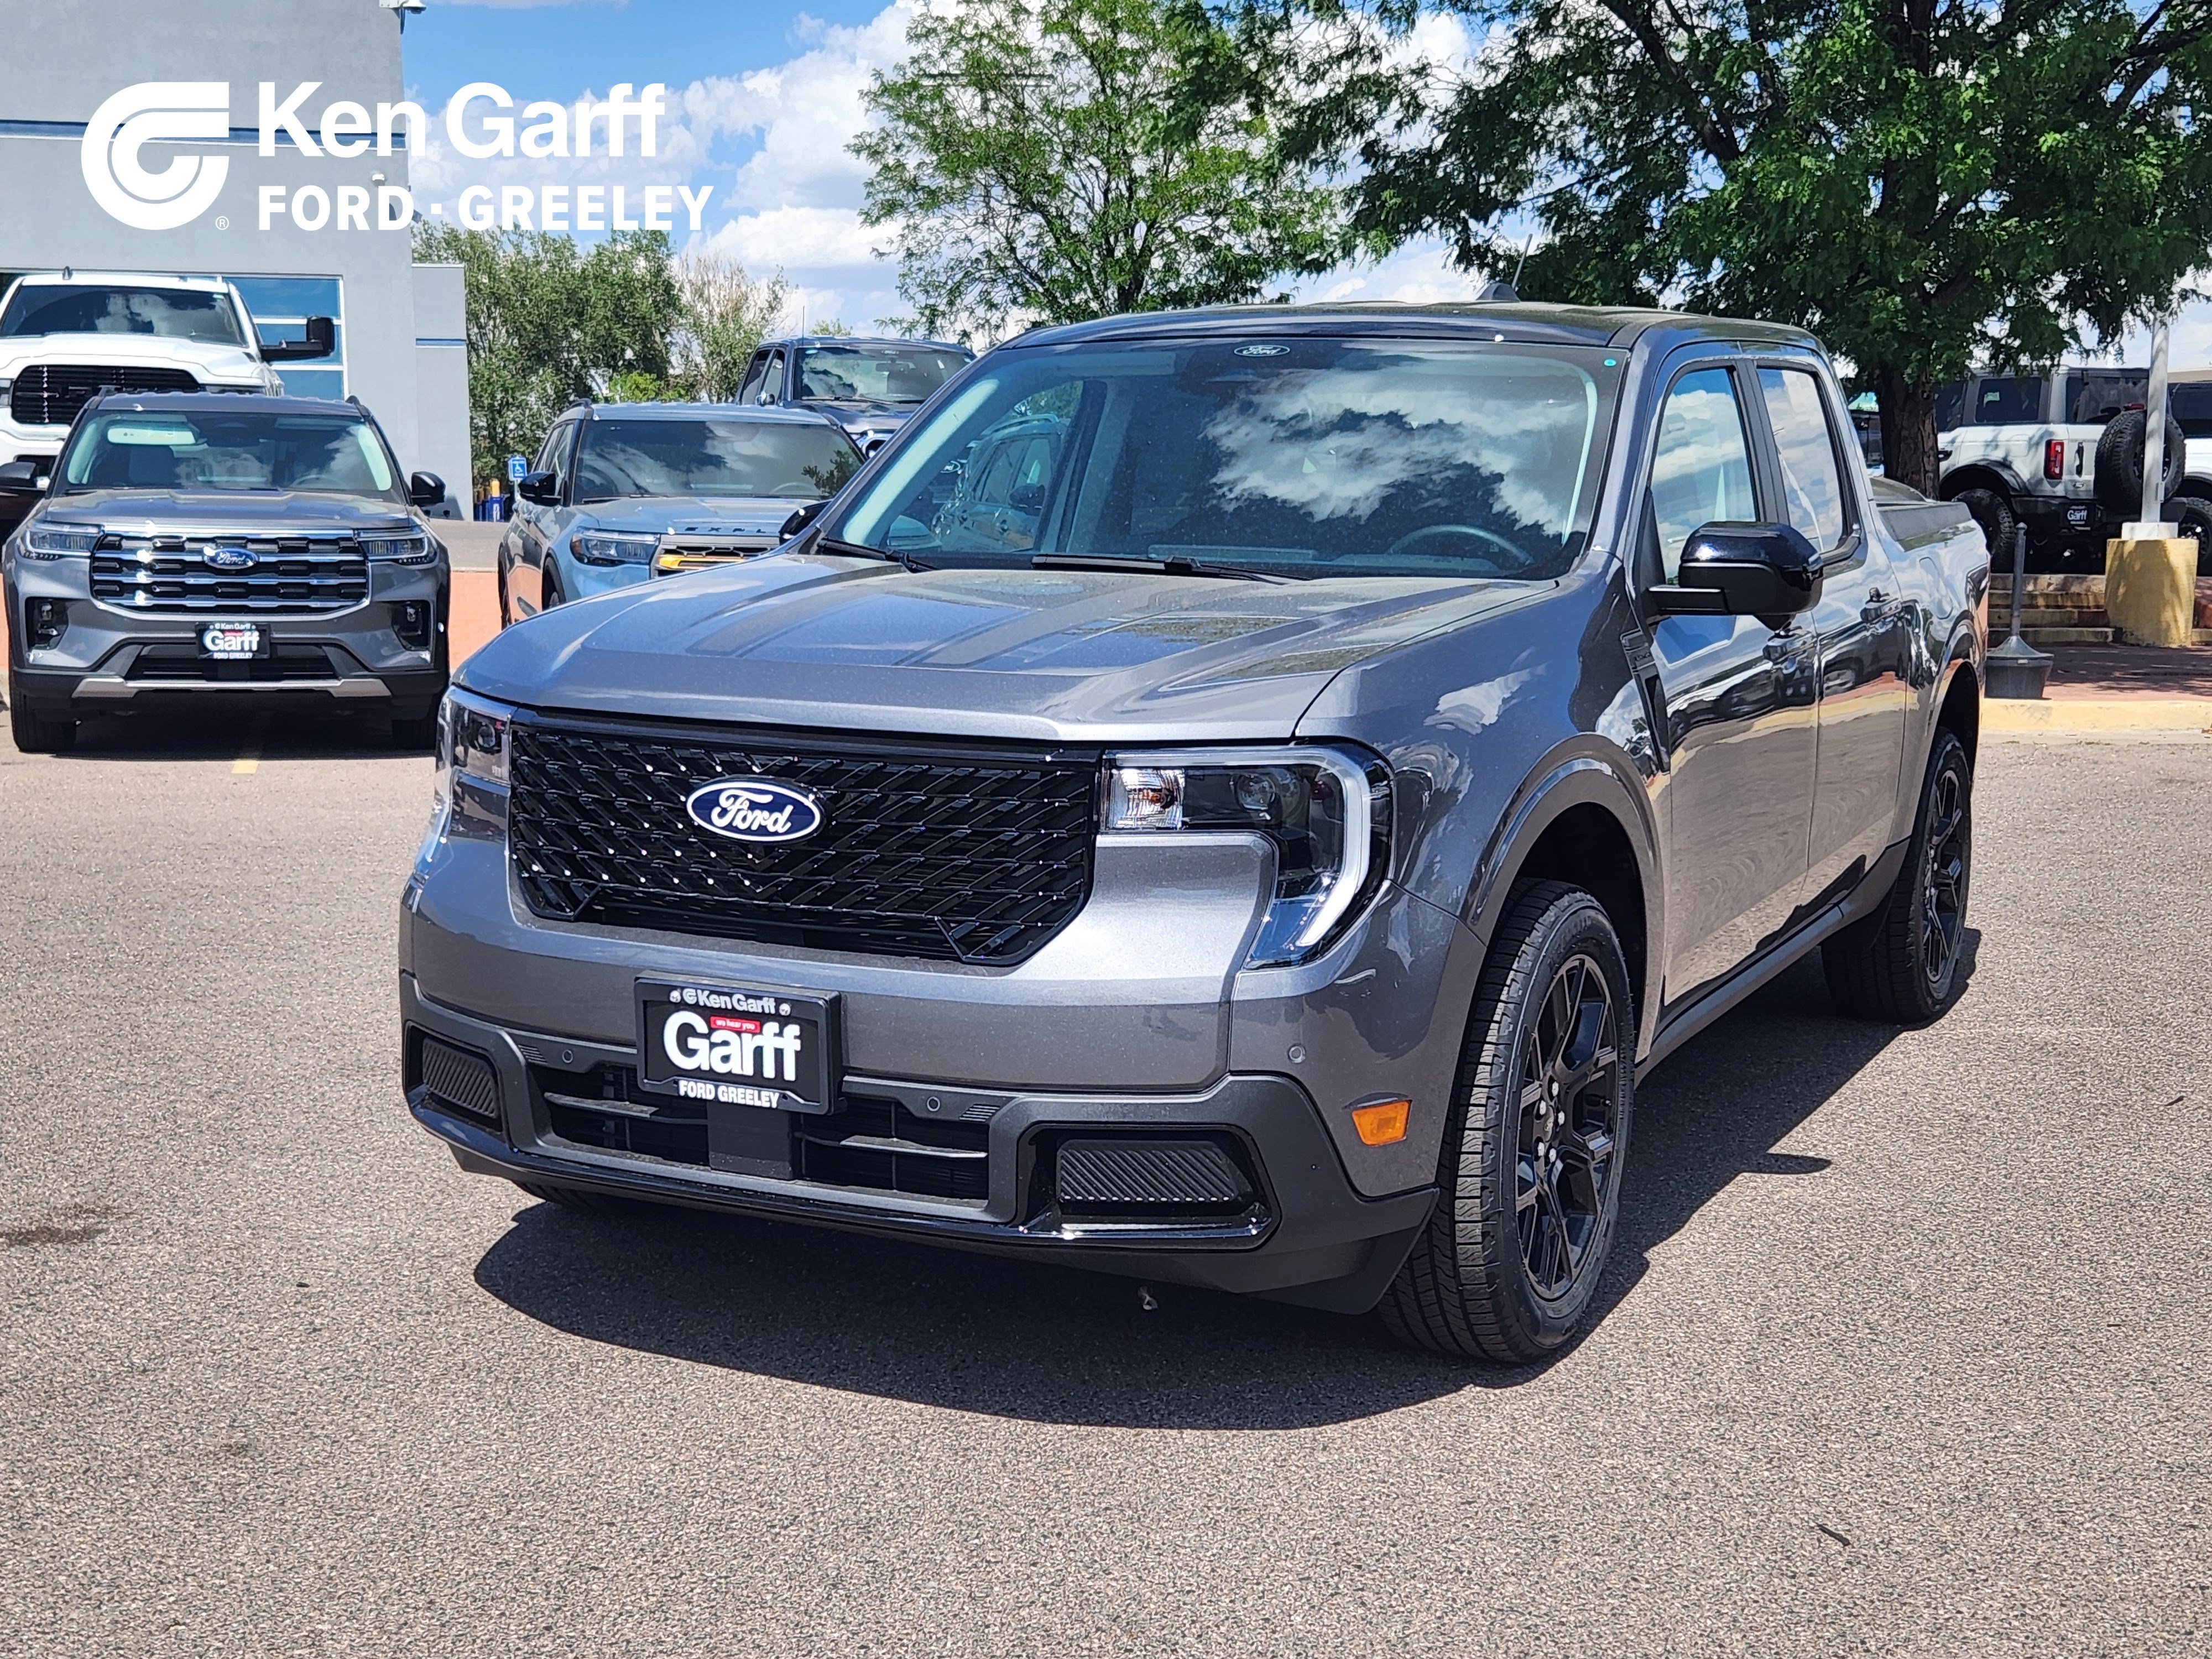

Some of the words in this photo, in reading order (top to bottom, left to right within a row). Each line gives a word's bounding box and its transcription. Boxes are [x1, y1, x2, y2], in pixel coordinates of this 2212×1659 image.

[1243, 346, 1281, 354] Ford
[217, 552, 246, 564] Ford
[204, 630, 259, 651] Garff
[710, 789, 794, 833] Ford
[696, 989, 733, 1010] Ken
[732, 993, 776, 1014] Garff
[663, 1010, 802, 1082] Garff
[678, 1079, 716, 1101] FORD
[718, 1085, 780, 1109] GREELEY
